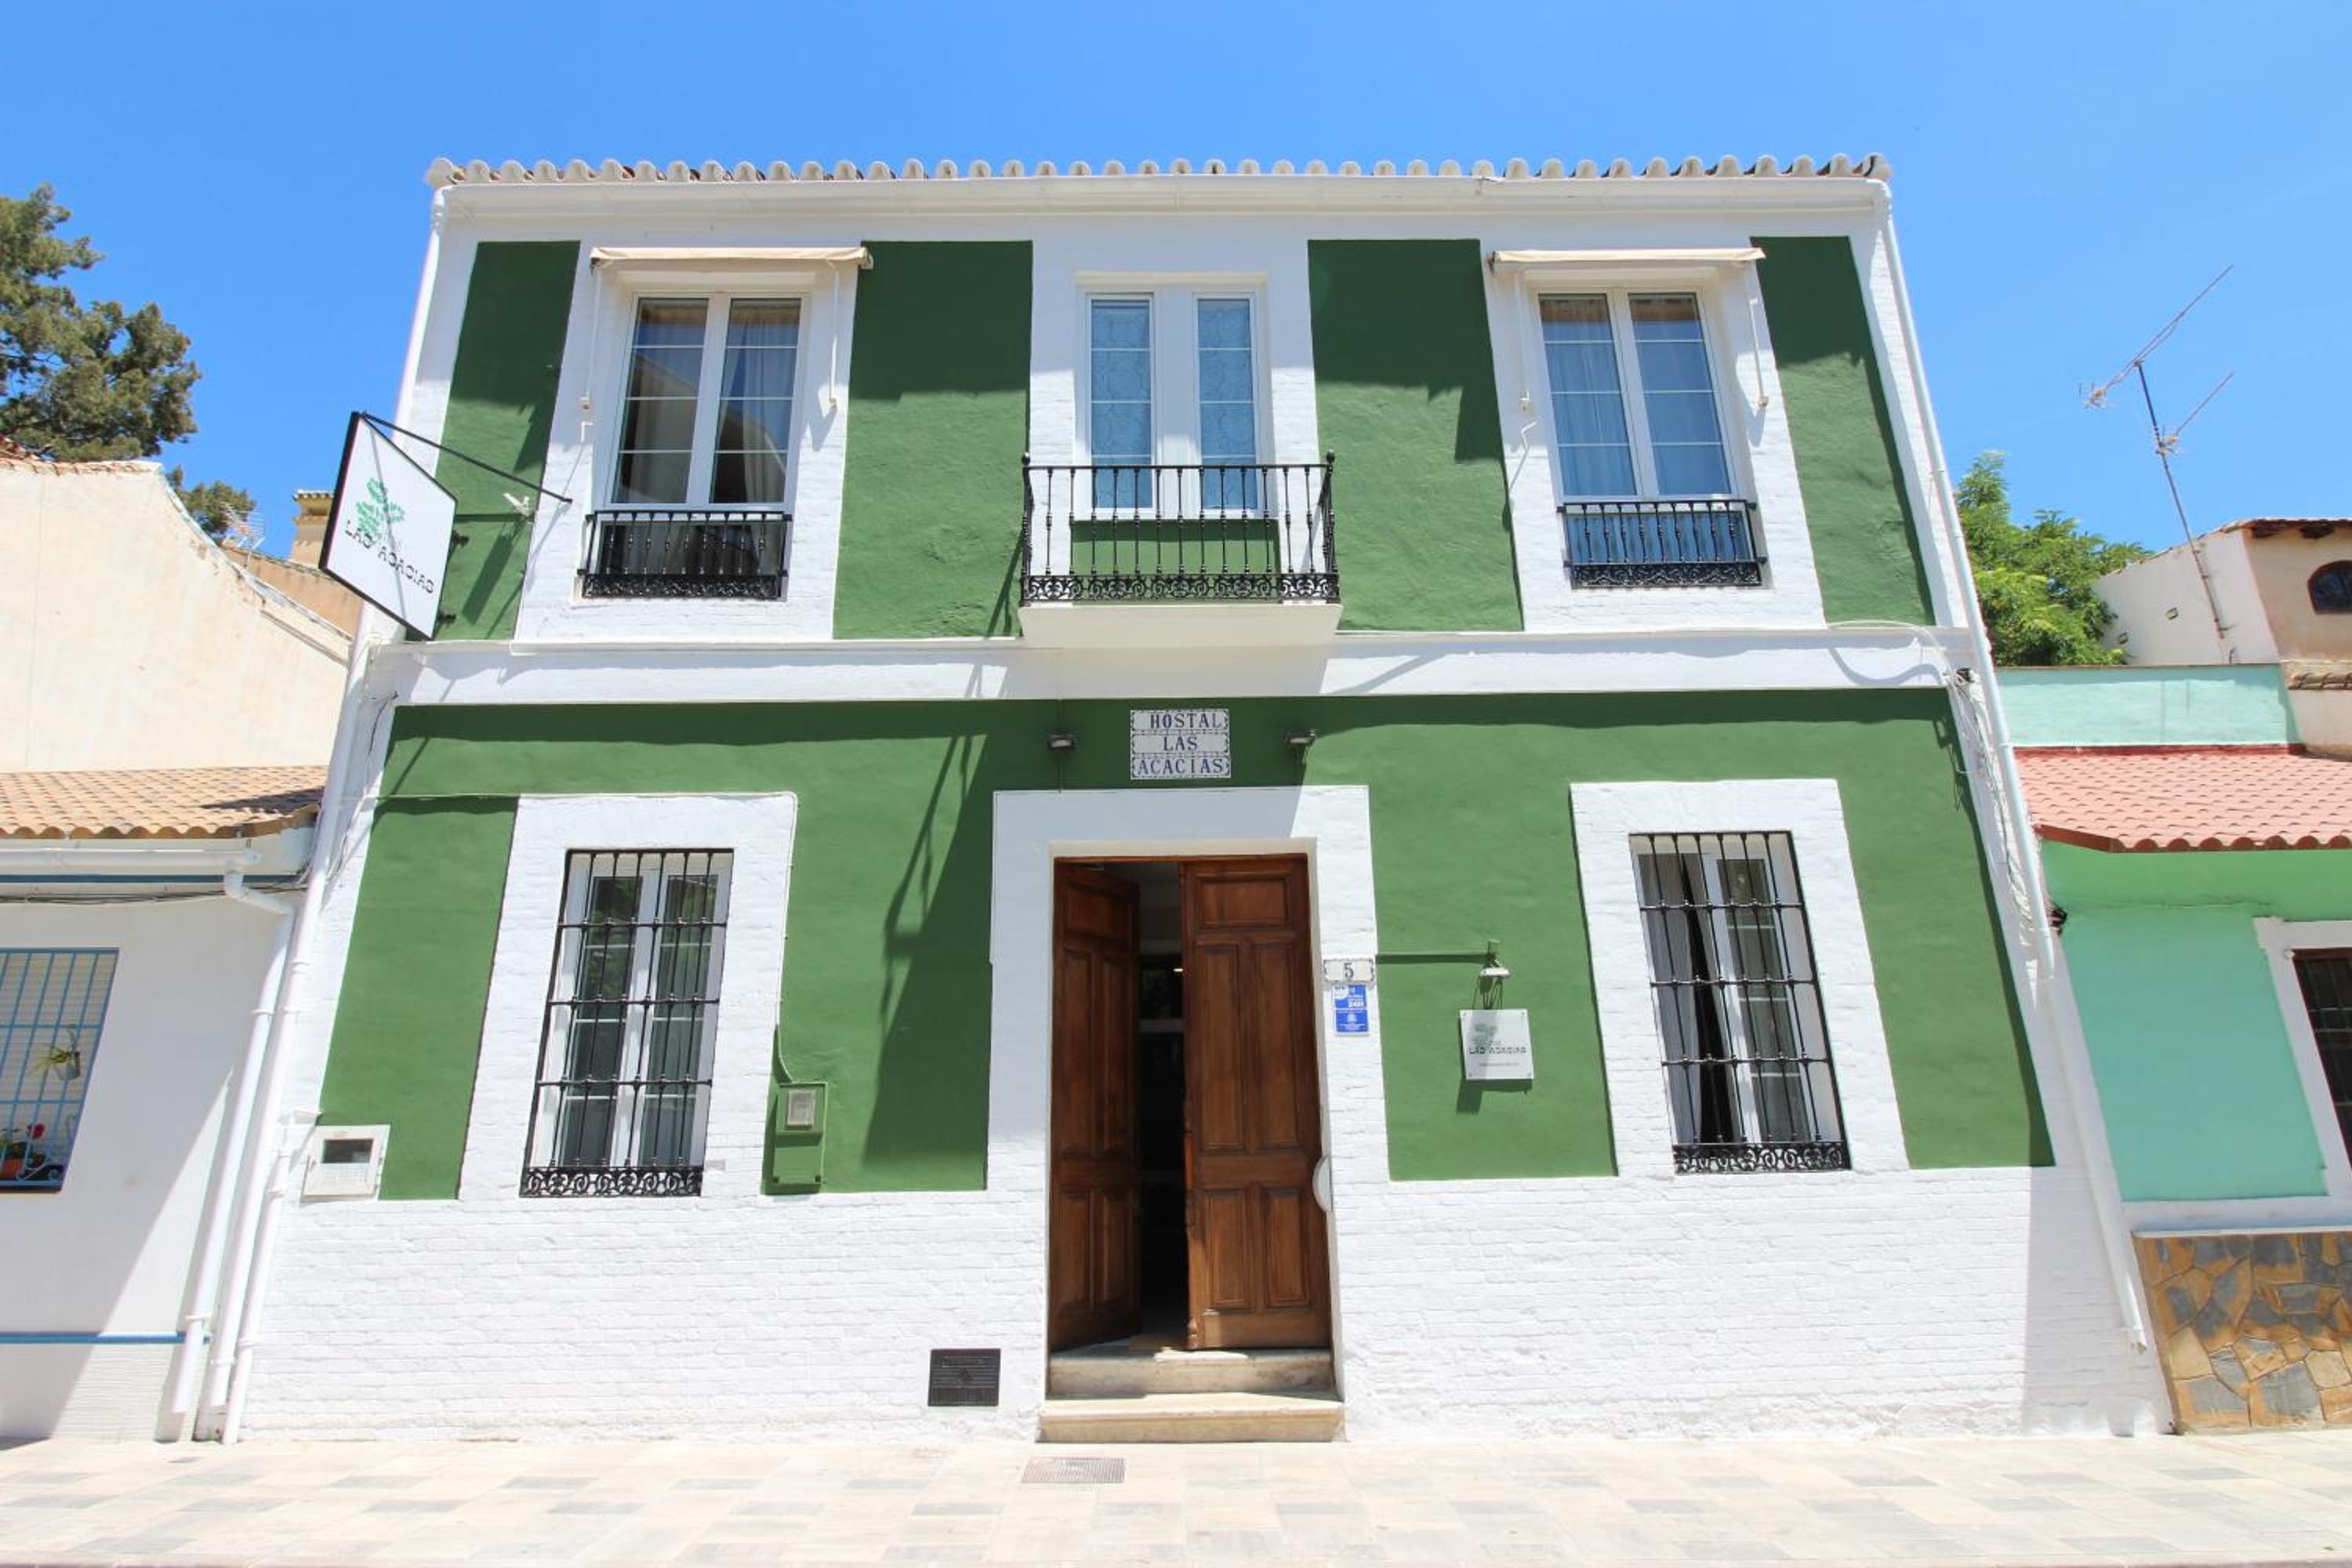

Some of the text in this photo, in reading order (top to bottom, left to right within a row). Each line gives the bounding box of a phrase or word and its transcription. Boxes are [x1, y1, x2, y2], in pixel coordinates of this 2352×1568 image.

[345, 519, 434, 594] LAS ACACIAS
[1149, 713, 1222, 729] HOSTAL
[1163, 736, 1198, 752] LAS
[1138, 758, 1224, 775] ACACIAS
[1343, 962, 1355, 979] 5
